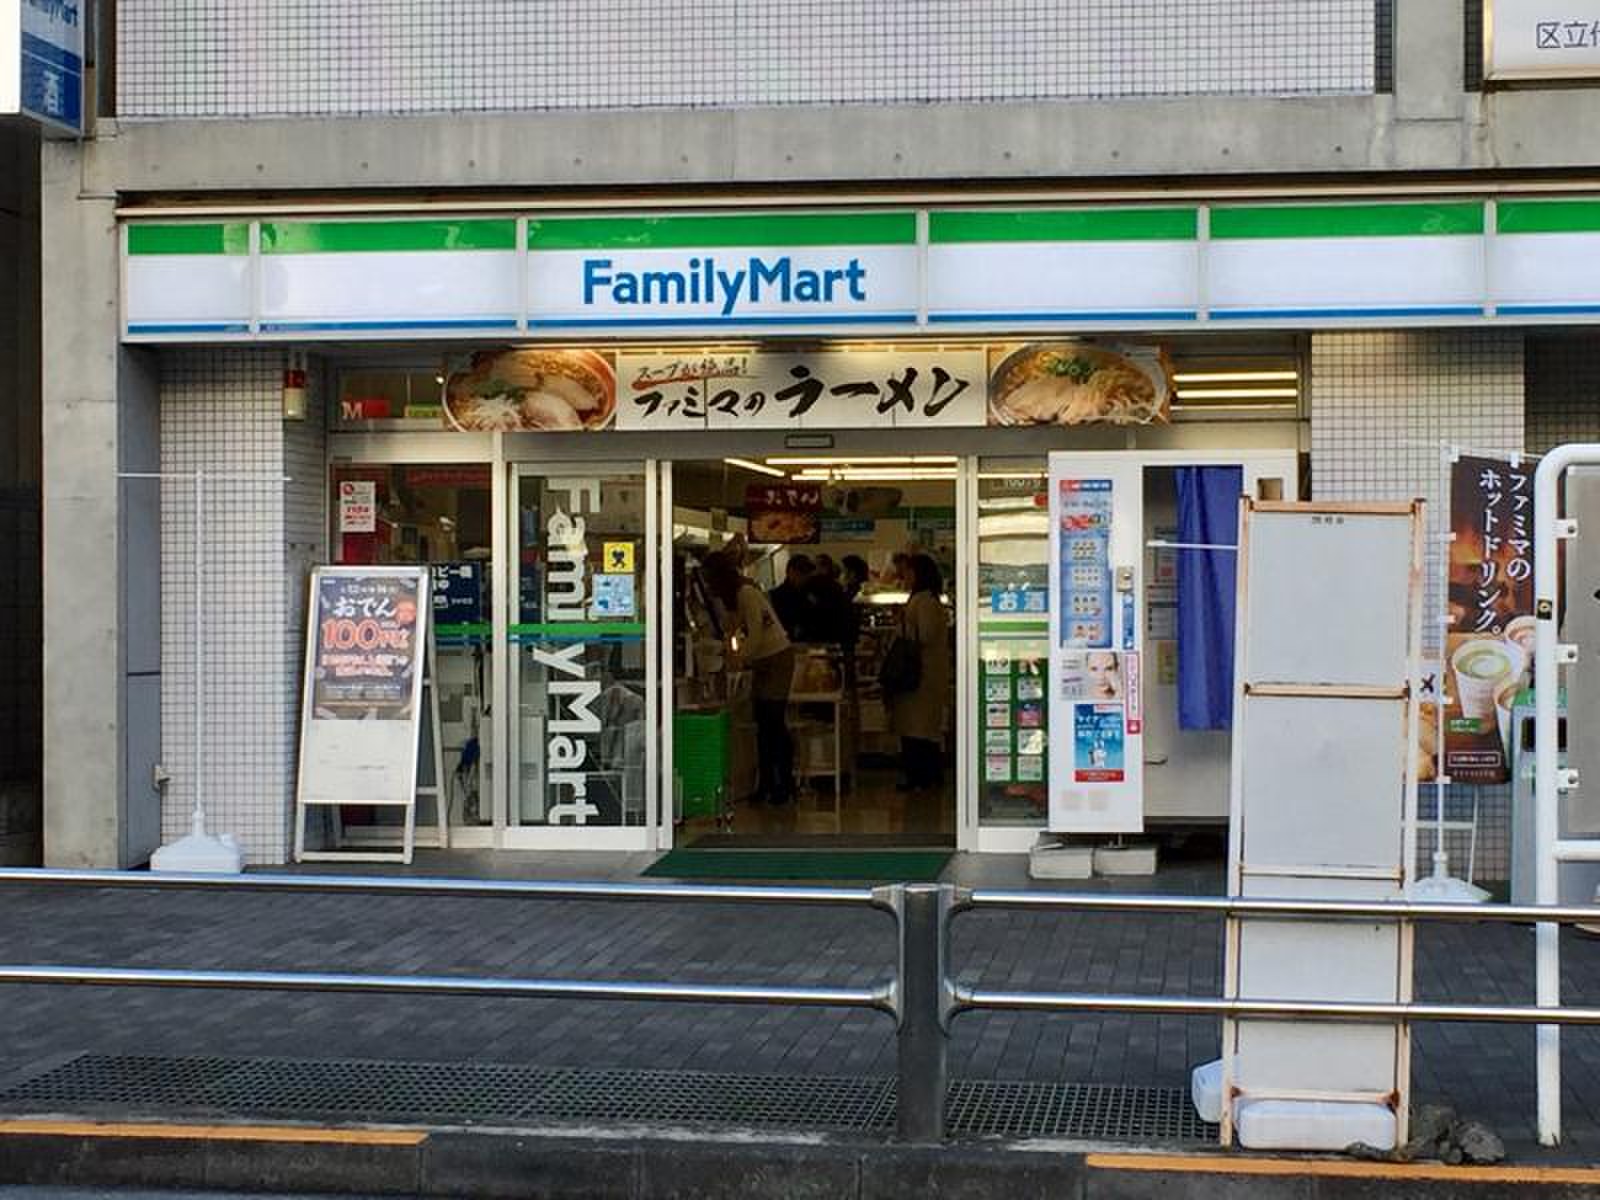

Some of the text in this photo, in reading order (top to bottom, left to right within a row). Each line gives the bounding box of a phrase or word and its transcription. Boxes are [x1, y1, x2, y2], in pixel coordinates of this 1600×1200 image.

[584, 257, 866, 315] FamilyMart
[1475, 469, 1502, 635] ホットドリンク。
[1506, 473, 1531, 581] ファミマの
[333, 596, 396, 616] おでん
[533, 479, 600, 824] FamiyMart
